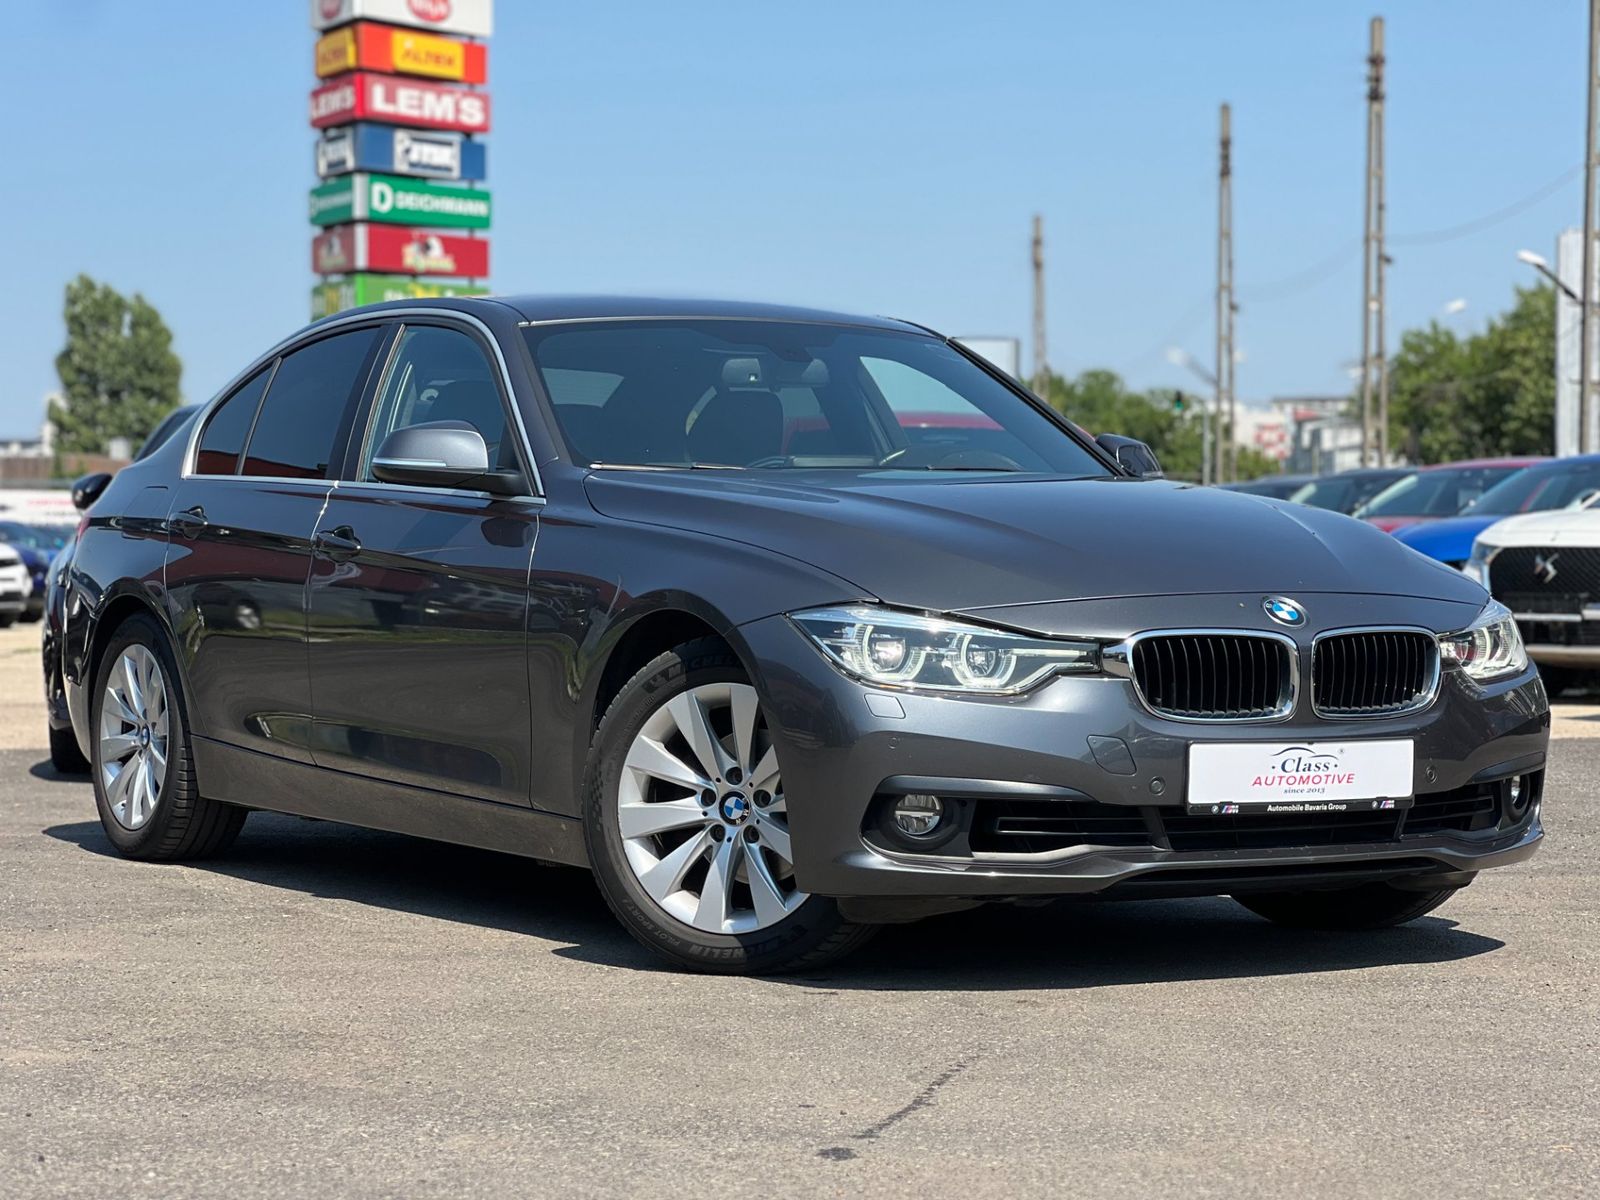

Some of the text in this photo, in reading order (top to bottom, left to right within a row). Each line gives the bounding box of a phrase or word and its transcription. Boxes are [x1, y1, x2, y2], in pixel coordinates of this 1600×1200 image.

[396, 190, 488, 217] DEICHMANN
[1281, 757, 1330, 773] Class
[1252, 773, 1355, 786] AUTOMOTIVE
[1306, 787, 1325, 795] 2013
[1267, 802, 1347, 813] Automobile Bavaria Group
